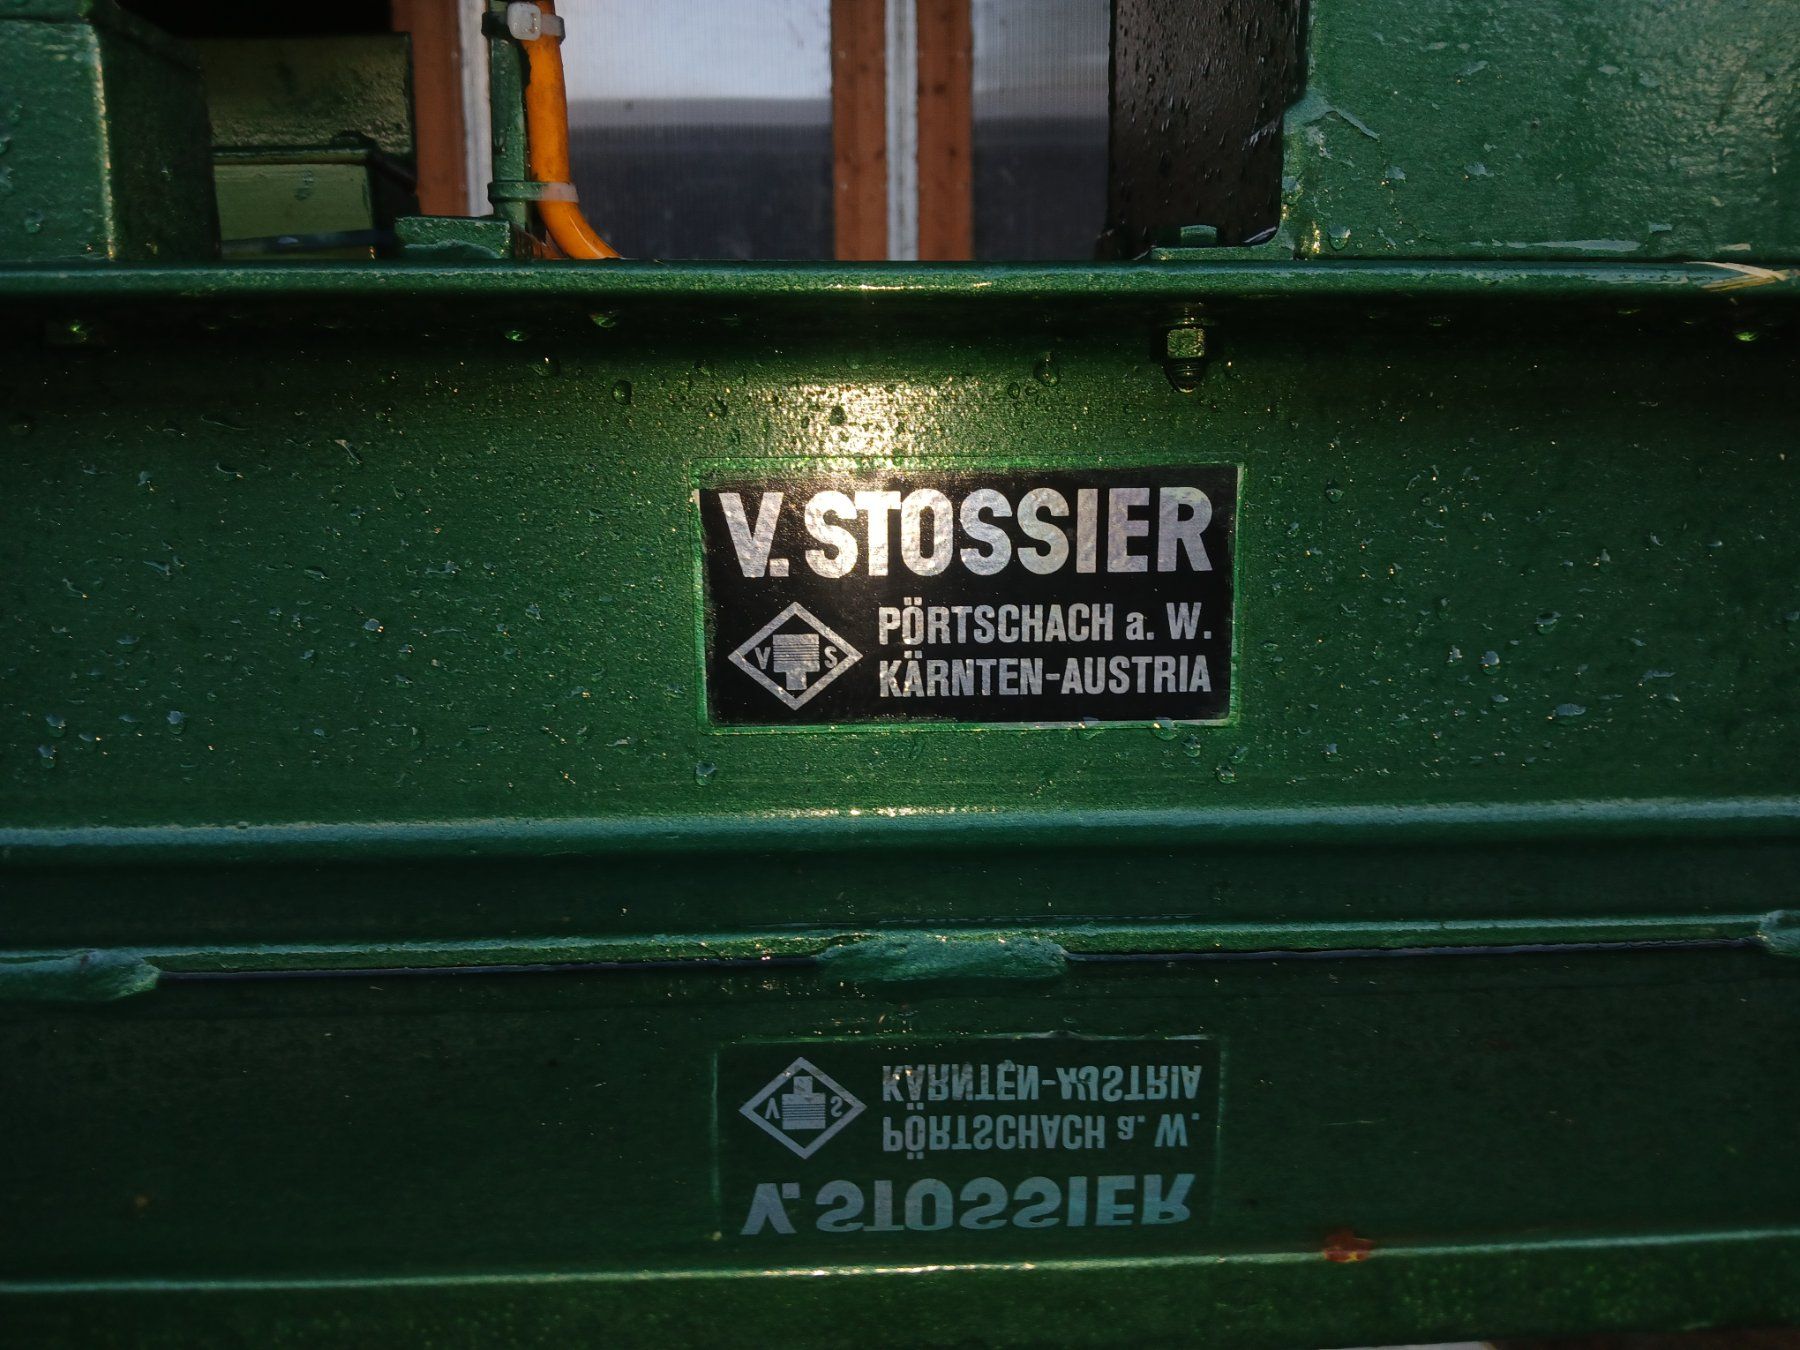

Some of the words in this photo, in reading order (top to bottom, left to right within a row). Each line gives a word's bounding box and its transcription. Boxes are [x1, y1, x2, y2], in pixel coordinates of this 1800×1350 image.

[719, 491, 789, 578] V.
[804, 486, 1212, 578] STOSSIER
[878, 597, 1113, 645] PÖRTSCHACH
[1125, 610, 1153, 641] a.
[1166, 602, 1212, 641] W.
[879, 651, 1212, 698] KÄRNTEN-AUSTRIA
